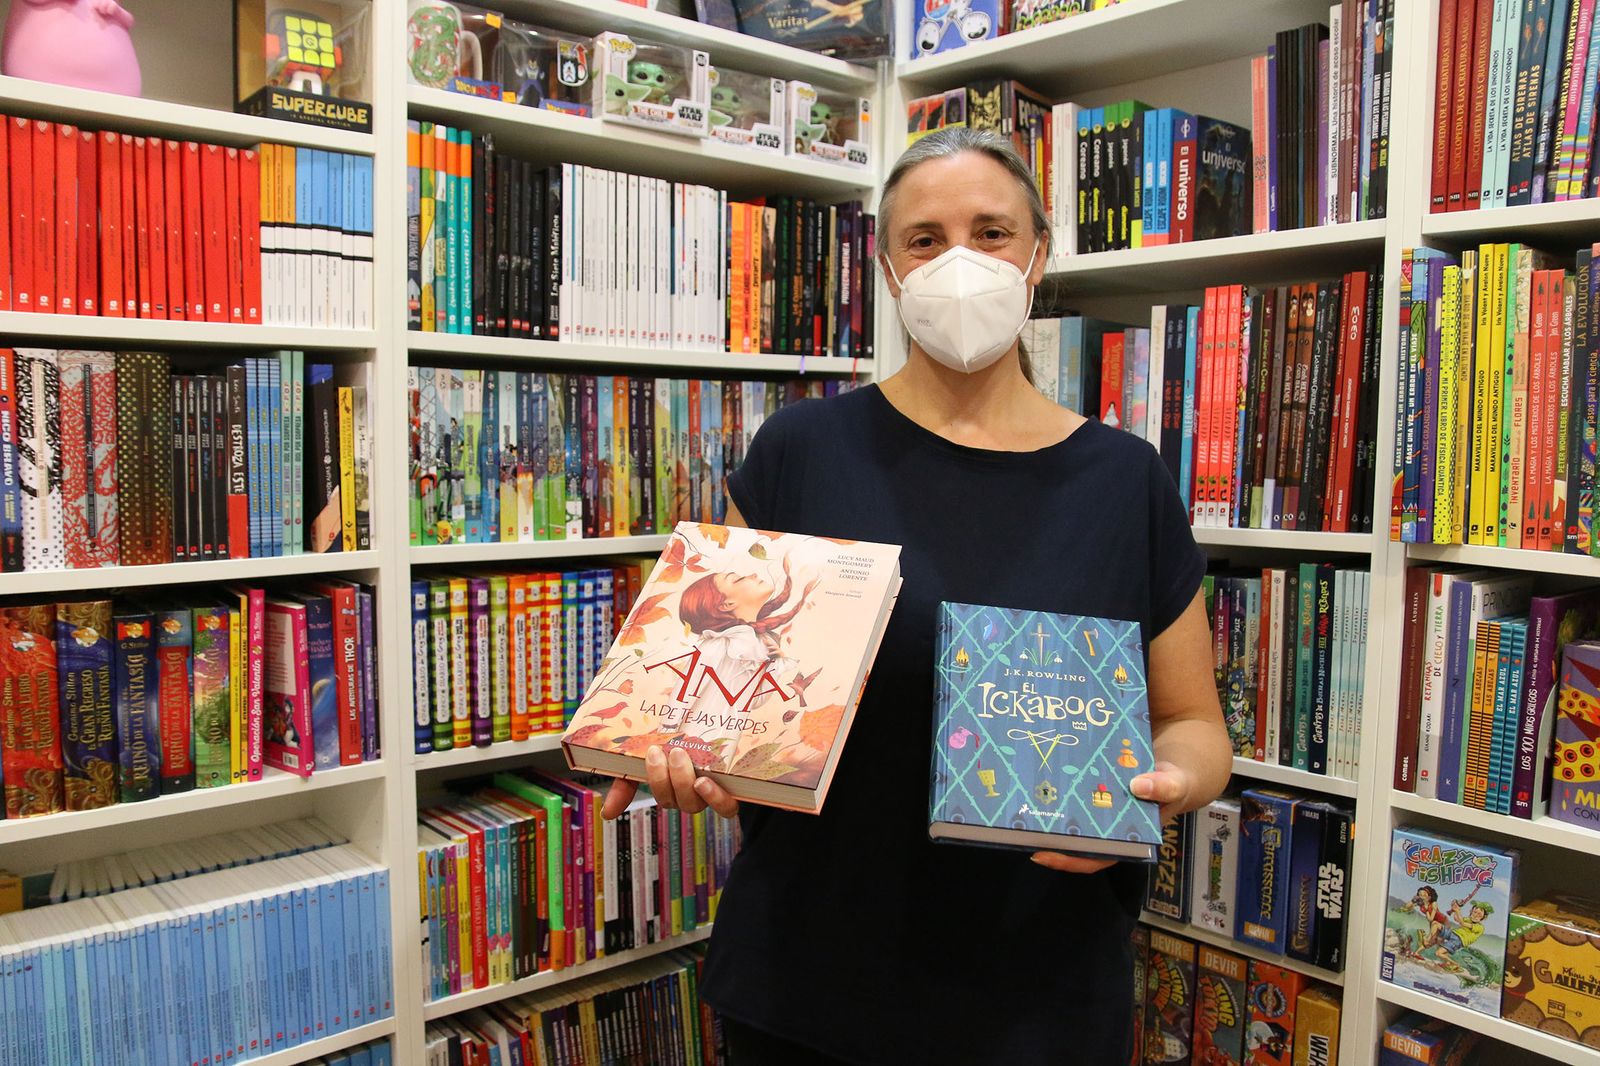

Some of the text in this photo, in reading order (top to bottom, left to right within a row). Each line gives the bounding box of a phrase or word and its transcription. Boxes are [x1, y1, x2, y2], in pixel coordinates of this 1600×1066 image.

[768, 15, 808, 29] Varitas
[1333, 71, 1338, 80] de
[1560, 68, 1571, 108] BRUJAS
[272, 93, 368, 124] SUPERCUBE
[1512, 71, 1527, 162] ATLAS DE SIRENAS
[1523, 65, 1540, 157] ATLAS DE SIRENAS
[1079, 141, 1088, 180] Coreano
[1093, 138, 1101, 177] Coreano
[1331, 130, 1339, 178] SUBNORMAL.
[1177, 158, 1192, 221] universo
[551, 258, 559, 280] Siete
[550, 282, 558, 296] Los
[1574, 266, 1589, 347] LA EVOLUCIÓN
[1409, 354, 1417, 362] EL
[1410, 362, 1416, 372] EN
[1588, 352, 1598, 376] ciencia
[1409, 397, 1415, 407] UN
[1561, 376, 1569, 406] ESCUCHA
[1588, 387, 1597, 402] para
[1183, 394, 1195, 438] VALEROSAS
[1585, 404, 1596, 424] pasos
[1440, 433, 1446, 441] DE
[1585, 426, 1595, 439] 100
[1, 410, 13, 486] NICO BRAVO
[231, 424, 245, 494] DESTROZA ESTE
[1557, 452, 1565, 473] PETER
[1434, 606, 1443, 632] TIERRA
[344, 638, 354, 662] THOR
[1434, 641, 1443, 664] CIELO
[643, 645, 796, 713] ANA
[1027, 671, 1087, 683] ROWLING
[1433, 667, 1441, 677] DE
[3, 678, 12, 706] Stilton
[79, 670, 94, 711] REGRESO
[1022, 682, 1038, 694] EL
[251, 660, 261, 762] Operación San Valentín
[977, 682, 1115, 727] ICKABOG
[1496, 704, 1503, 712] EL
[80, 714, 96, 743] GRAN
[639, 700, 769, 735] LA DE TEJAS VERDES
[669, 739, 713, 752] EDELVIVES
[1522, 737, 1534, 753] 100
[133, 741, 148, 780] REINO
[1521, 756, 1531, 770] LOS
[1028, 808, 1065, 818] salamandra
[1404, 841, 1474, 865] CRAZY
[1317, 861, 1333, 911] STAR
[1324, 863, 1344, 919] WARS
[1152, 932, 1181, 956] DEVIR
[1205, 952, 1238, 978] DEVIR
[1382, 956, 1394, 979] DEVIR
[1170, 967, 1185, 1006] KING
[1214, 982, 1236, 1028] KING
[1390, 1035, 1422, 1059] DEVIR
